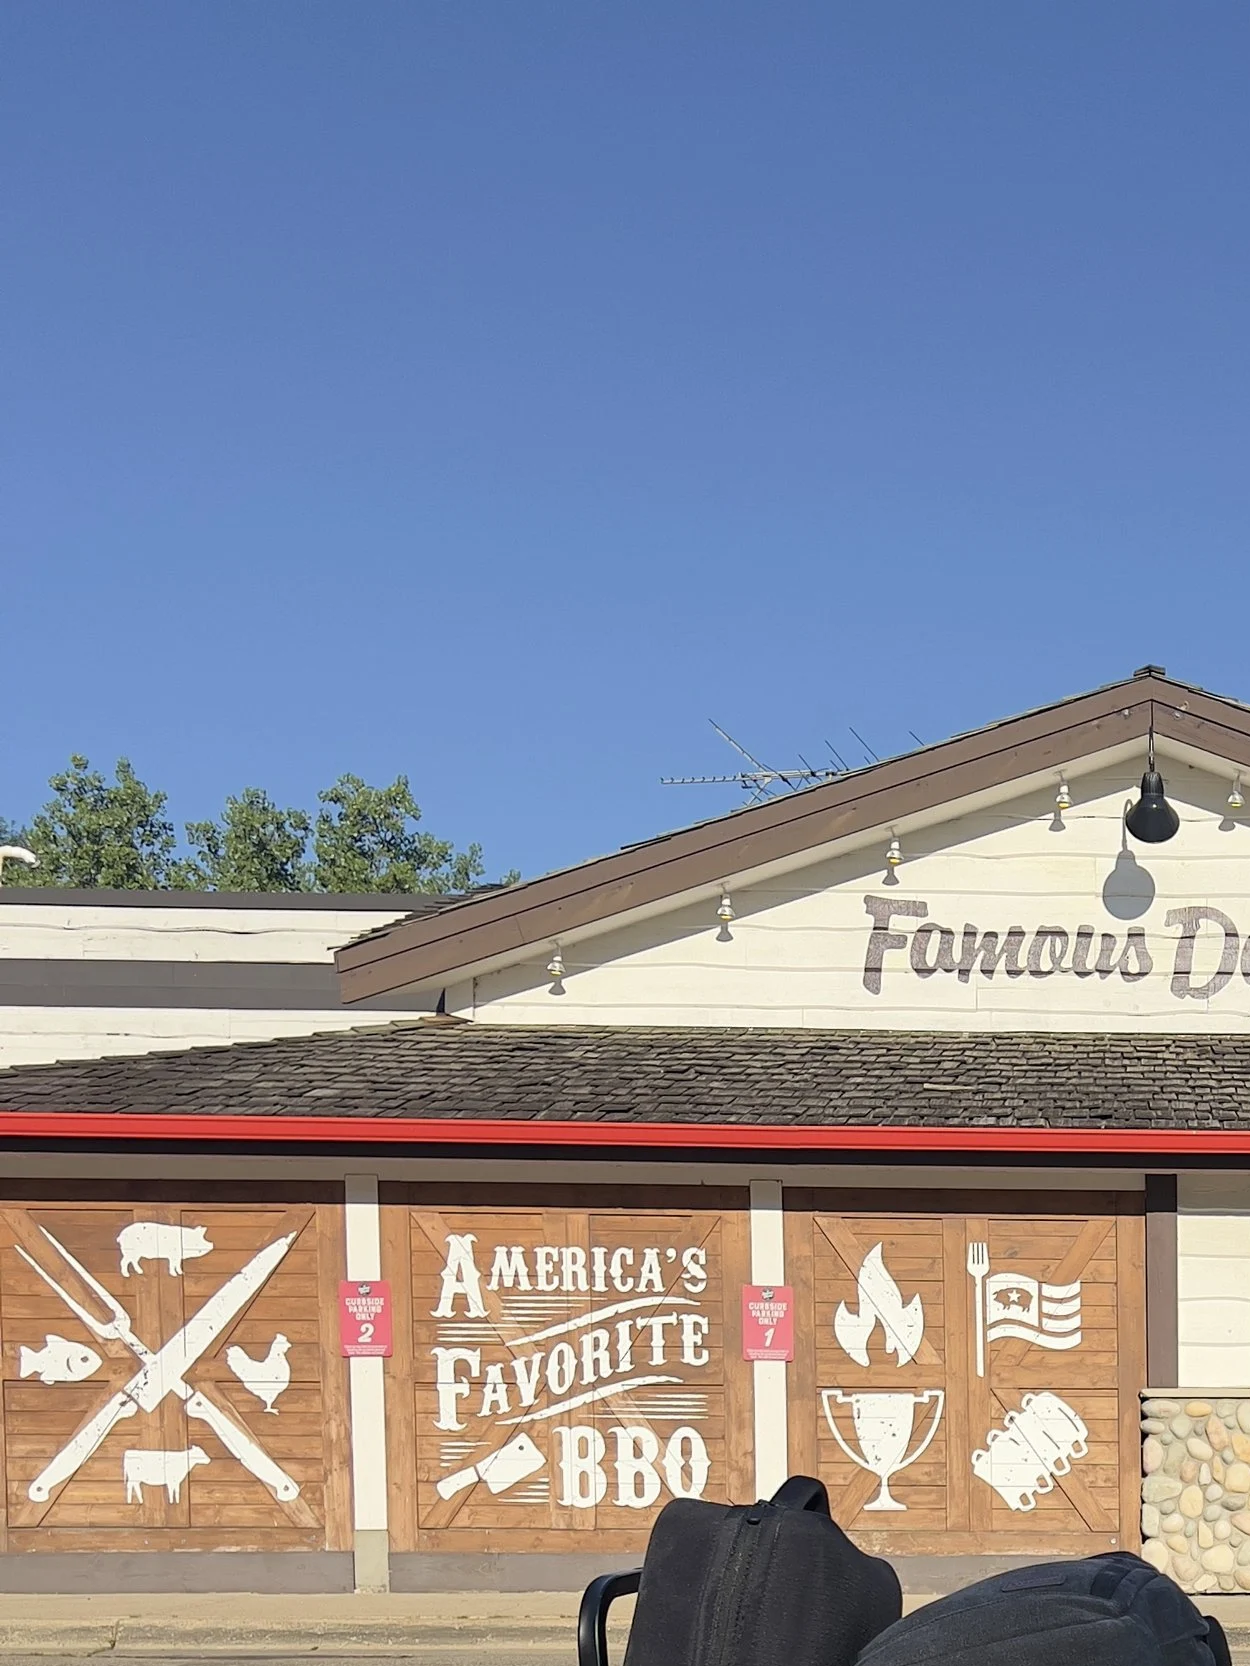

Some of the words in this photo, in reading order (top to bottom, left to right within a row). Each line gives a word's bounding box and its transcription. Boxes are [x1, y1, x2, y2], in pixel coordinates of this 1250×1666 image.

[863, 894, 1154, 995] Famous
[430, 1233, 708, 1318] AMERICA'S
[345, 1297, 385, 1306] CURBSIDE
[748, 1302, 788, 1310] CURBSIDE
[348, 1305, 382, 1313] PARKING
[751, 1310, 785, 1318] PARKING
[355, 1313, 375, 1321] ONLY
[758, 1317, 778, 1325] ONLY
[357, 1322, 375, 1343] 2
[764, 1327, 776, 1347] 1
[430, 1312, 710, 1431] FAVORITE
[551, 1425, 711, 1509] BBQ
